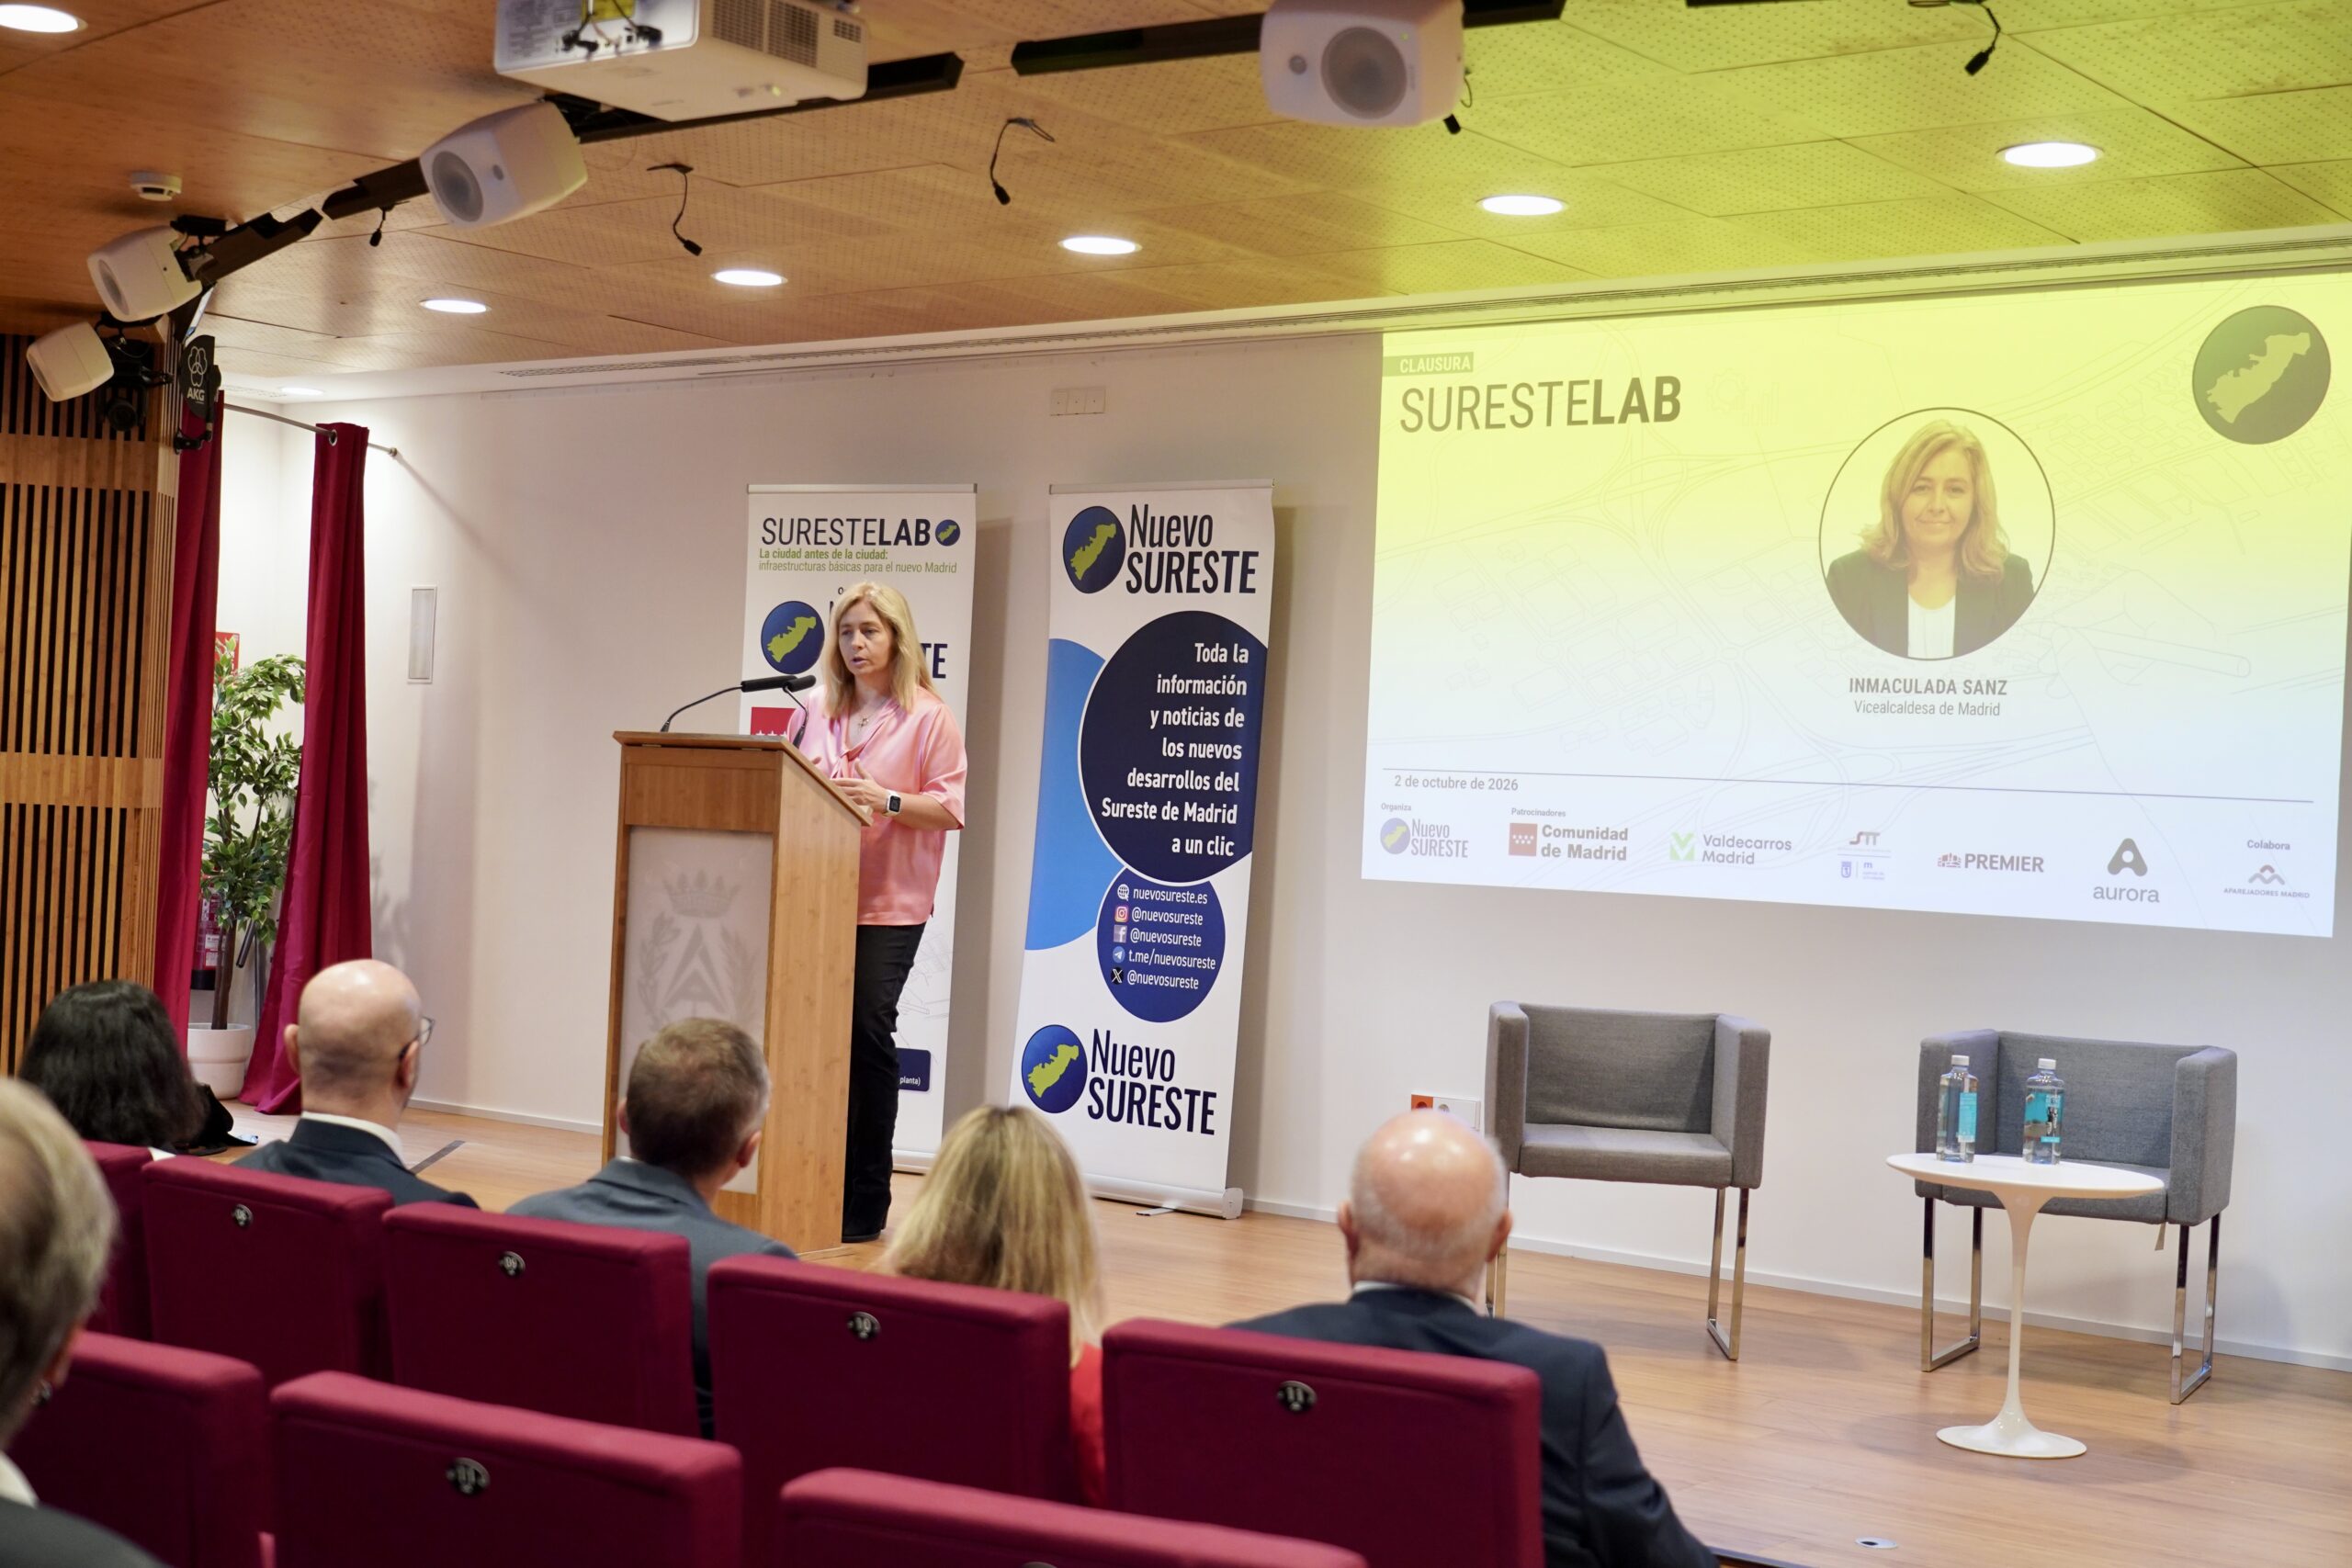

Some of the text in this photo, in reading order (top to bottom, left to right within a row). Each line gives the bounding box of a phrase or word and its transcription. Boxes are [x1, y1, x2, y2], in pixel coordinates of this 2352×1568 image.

[1399, 355, 1471, 374] CLAUSURA
[187, 388, 205, 401] AKG
[1400, 375, 1681, 433] SURESTELAB
[762, 517, 931, 546] SURESTELAB
[1129, 503, 1213, 548] Nuevo
[759, 548, 888, 560] La ciudad antes de la ciudad:
[759, 560, 957, 574] infraestructuras básicas para el nuevo Madrid
[1125, 550, 1259, 594] SURESTE
[1194, 643, 1249, 663] Toda la
[1157, 674, 1247, 695] información
[1849, 678, 2007, 695] INMACULADA SANZ
[1150, 706, 1245, 729] y noticias de
[1854, 700, 2000, 716] Vicealcaldesa de Madrid
[1162, 738, 1242, 761] los nuevos
[1127, 768, 1239, 792] desarrollos del
[1395, 775, 1519, 791] 2 de octubre de 2026
[1102, 797, 1238, 825] Sureste de Madrid
[1381, 803, 1412, 812] Organiza
[1511, 807, 1566, 818] Patrocinadores
[1411, 818, 1450, 839] Nuevo
[1542, 824, 1629, 841] Comunidad
[1171, 836, 1235, 857] a un clic
[1410, 838, 1469, 858] SURESTE
[1541, 843, 1627, 861] de Madrid
[1703, 834, 1792, 852] Valdecarros
[2246, 840, 2290, 851] Colabora
[1702, 850, 1755, 865] Madrid
[1964, 852, 2044, 874] PREMIER
[1133, 887, 1208, 906] nuevosureste.es
[2092, 885, 2161, 904] aurora
[1132, 907, 1204, 926] @nuevosureste
[1130, 928, 1202, 947] @nuevosureste
[1128, 948, 1216, 970] t.me/nuevosureste
[1127, 970, 1199, 989] @nuevosureste
[1091, 1028, 1176, 1082] Nuevo
[1088, 1077, 1217, 1136] SURESTE
